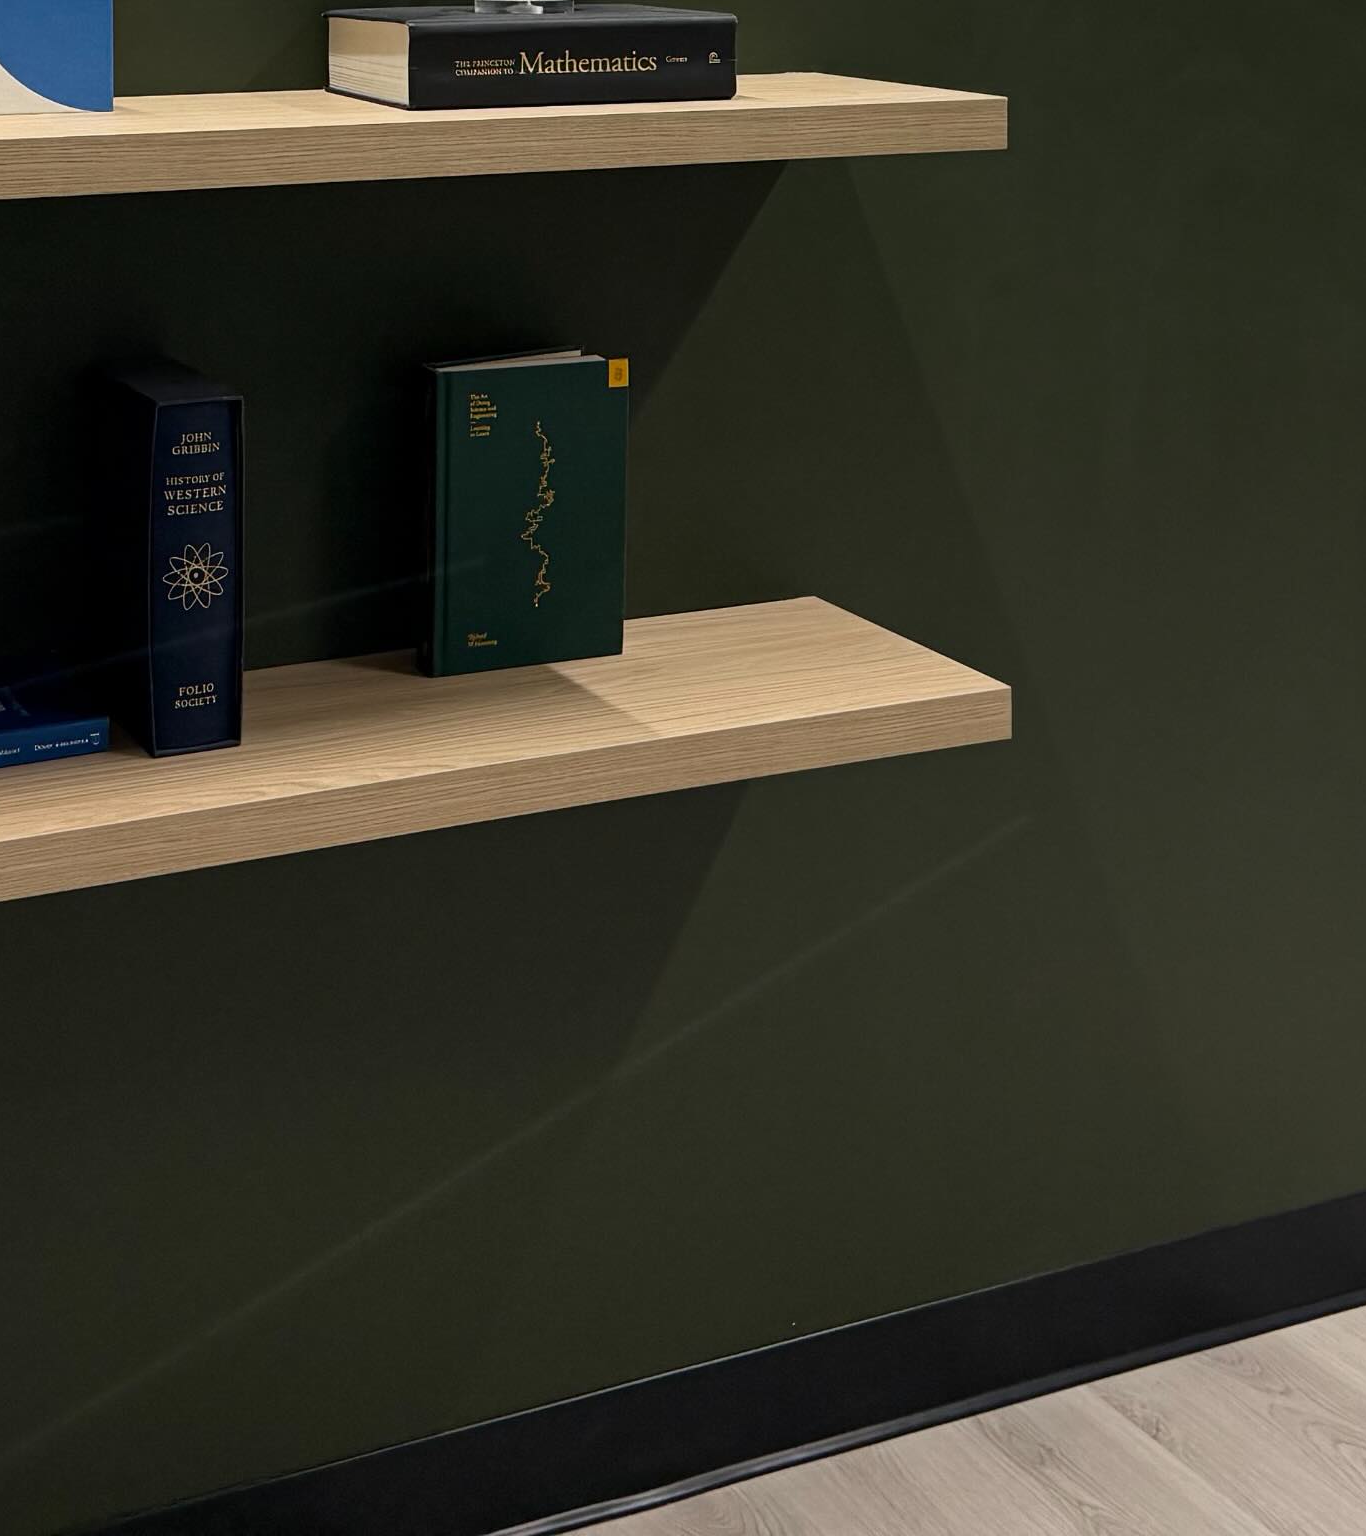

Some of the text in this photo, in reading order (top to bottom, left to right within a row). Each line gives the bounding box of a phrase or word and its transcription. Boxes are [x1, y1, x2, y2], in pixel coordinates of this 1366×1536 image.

[455, 59, 515, 68] THE PRINCETON
[519, 49, 657, 74] Mathematics
[455, 67, 514, 76] COMPANION TO
[181, 432, 211, 445] JOHN
[172, 442, 220, 455] GRIBBIN
[166, 472, 225, 485] HISTORY OF
[164, 485, 226, 500] WESTERN
[167, 500, 223, 516] SCIENCE
[179, 683, 214, 696] FOLIO
[175, 695, 217, 709] SOCIETY
